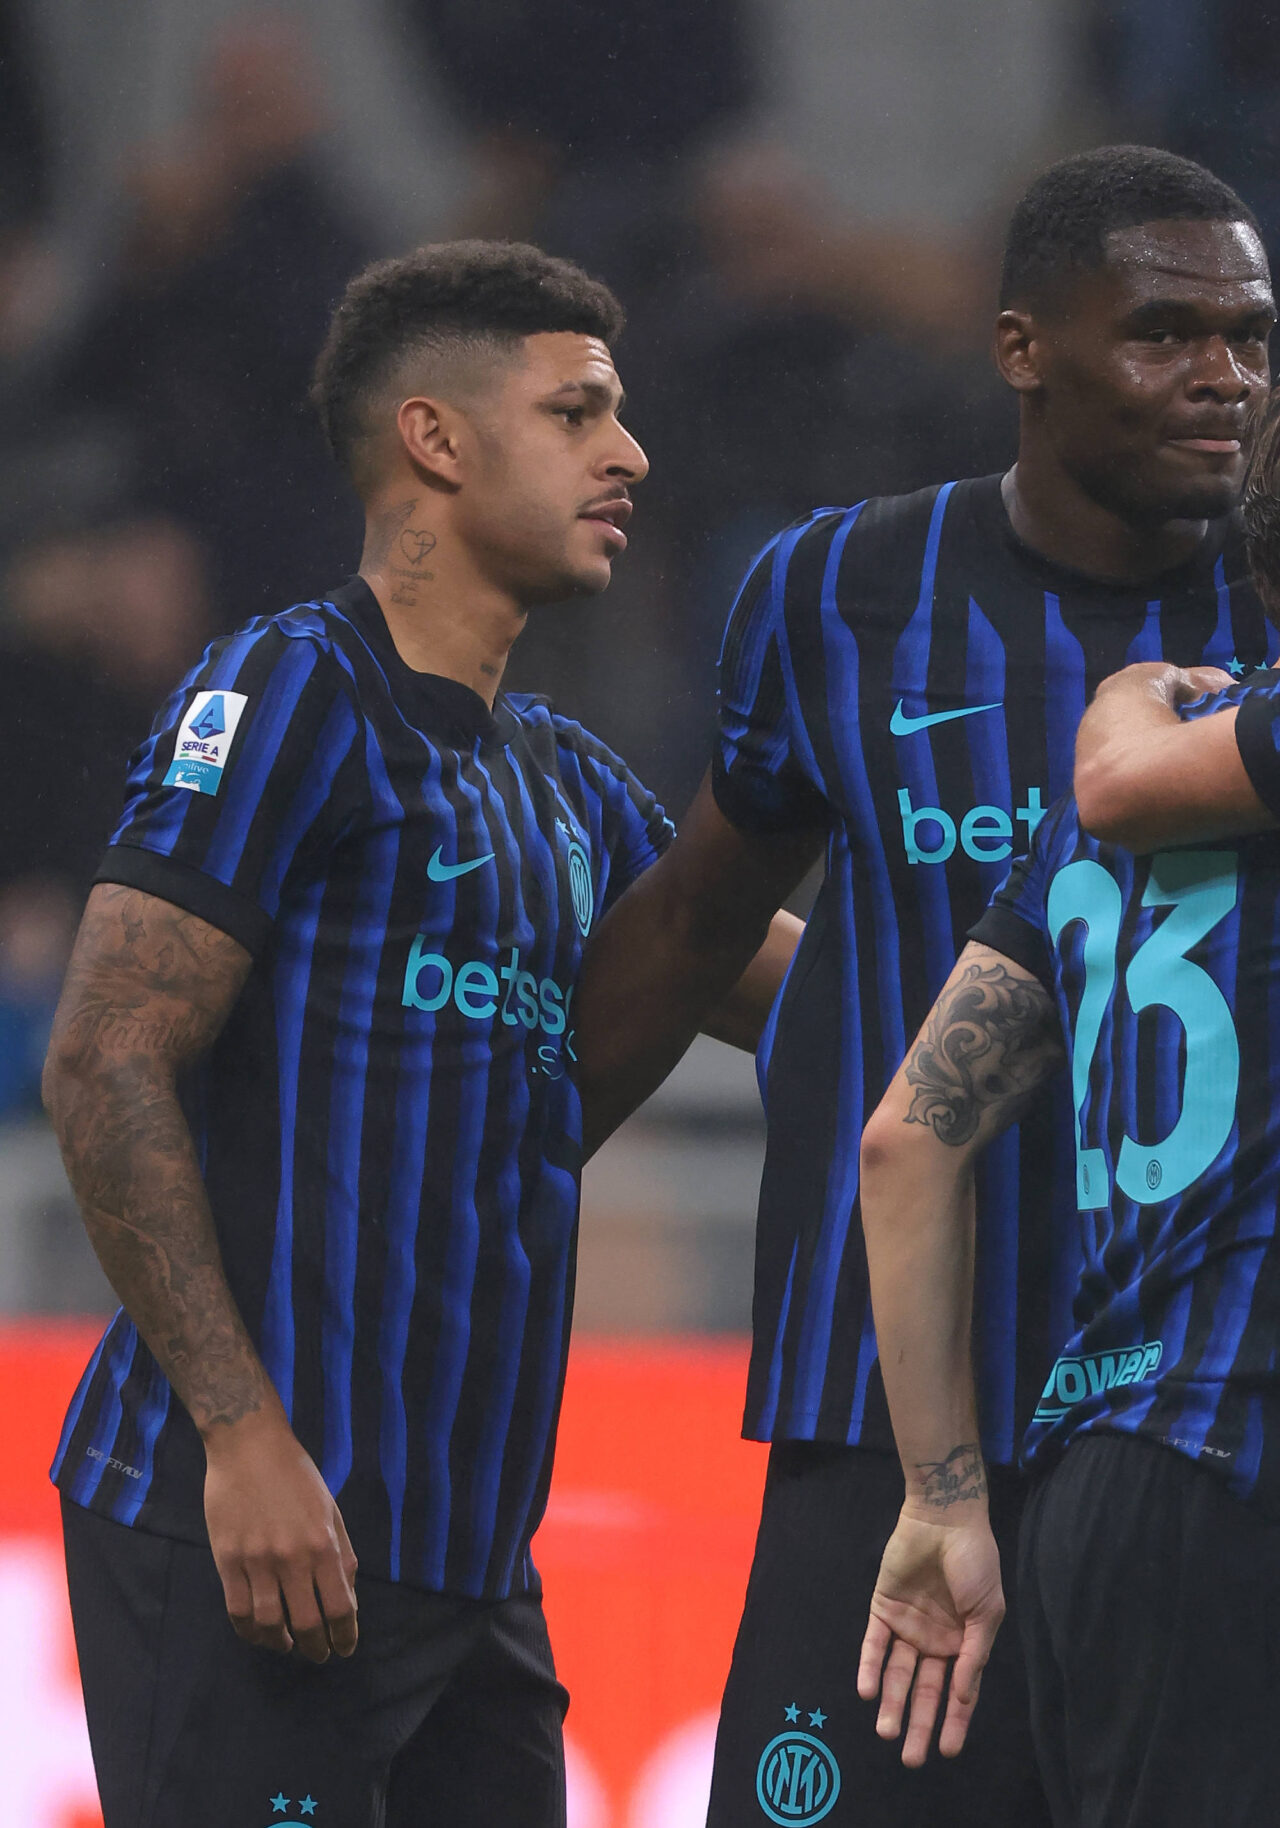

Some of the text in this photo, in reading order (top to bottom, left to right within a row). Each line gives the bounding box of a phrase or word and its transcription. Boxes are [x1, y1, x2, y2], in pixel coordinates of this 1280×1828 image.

[180, 740, 219, 757] SERIE A
[401, 933, 574, 1035] betss
[1047, 850, 1240, 1212] 23
